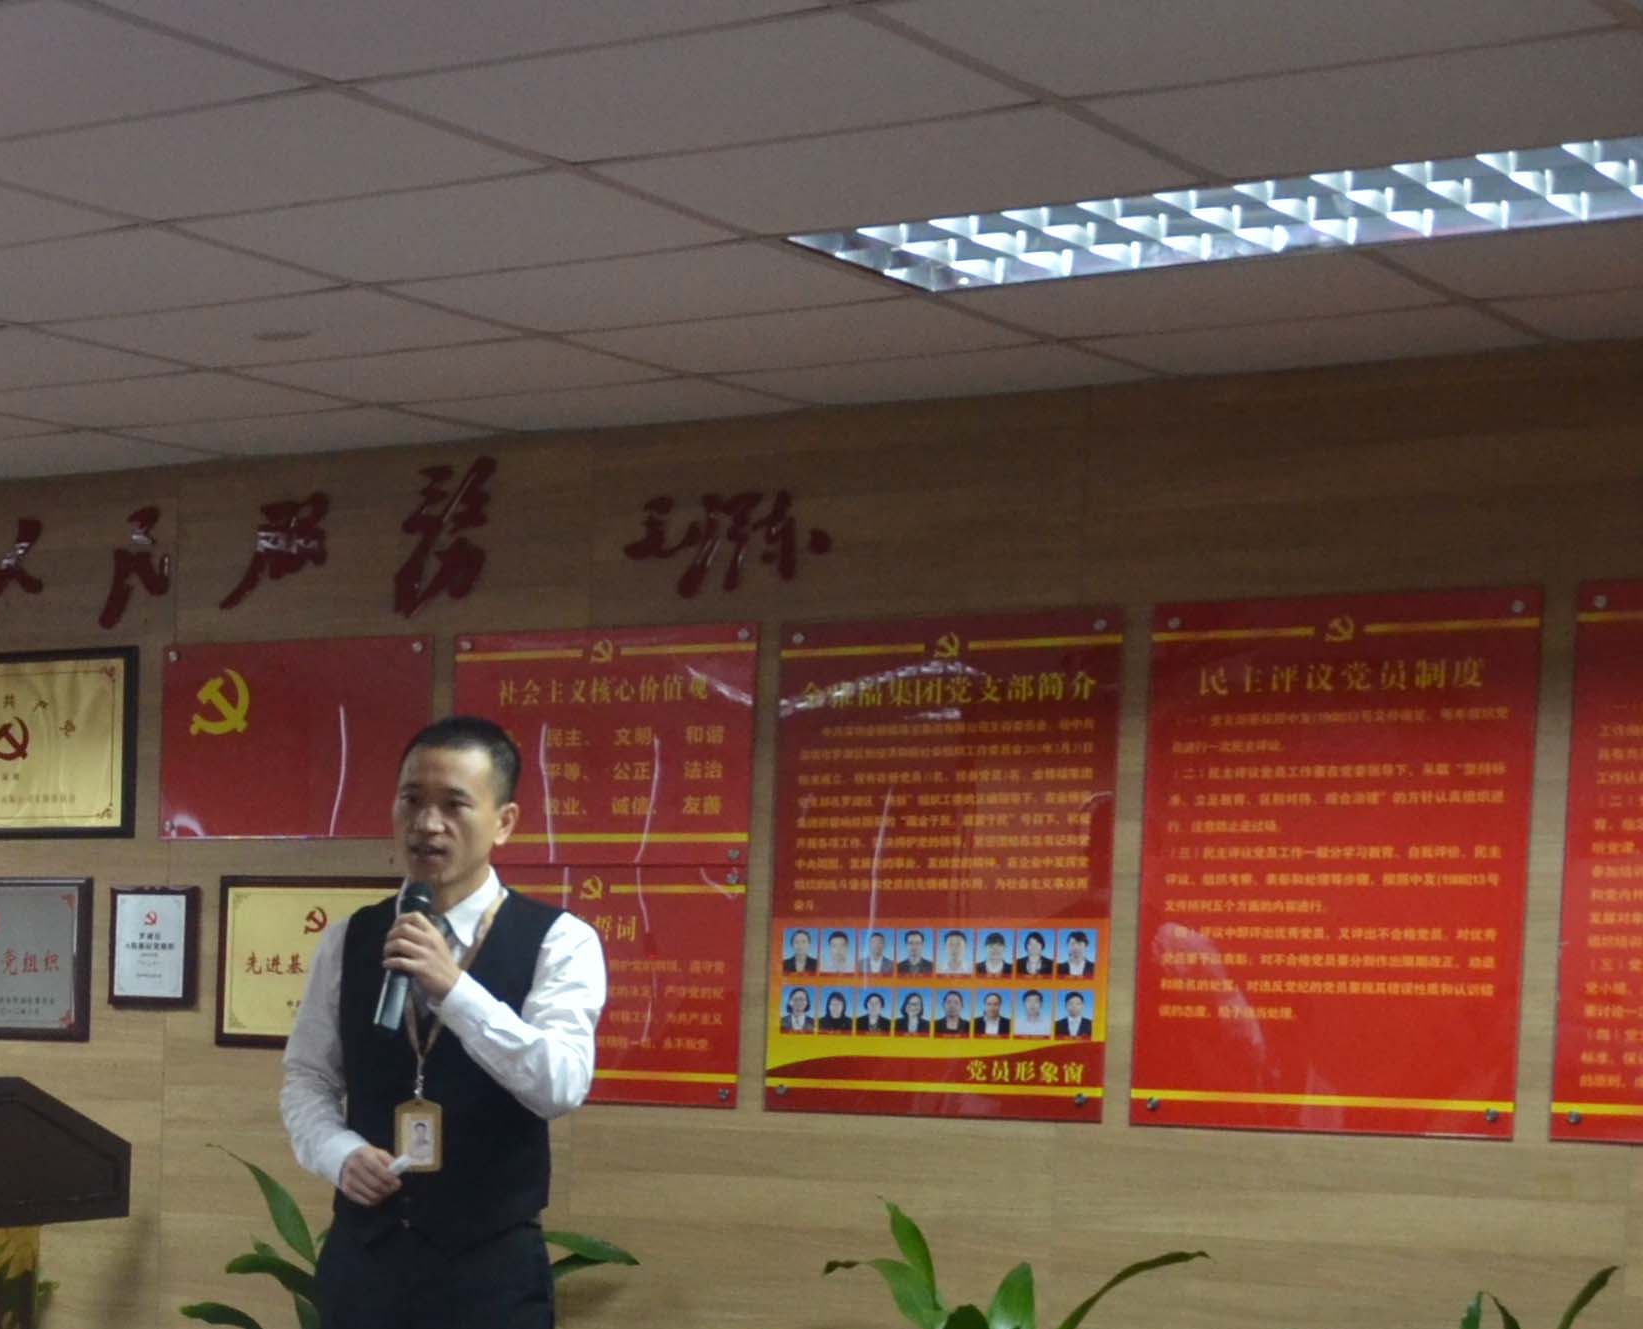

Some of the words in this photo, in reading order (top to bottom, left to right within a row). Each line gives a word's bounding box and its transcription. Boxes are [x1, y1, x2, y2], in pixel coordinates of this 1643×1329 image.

[1199, 656, 1485, 697] 民主评议党员制度
[499, 673, 711, 706] 社会主义核心价值观
[683, 725, 725, 745] 和谐
[682, 760, 724, 780] 法治
[682, 795, 723, 815] 友善
[577, 912, 637, 942] 誓词
[245, 951, 309, 976] 先进基
